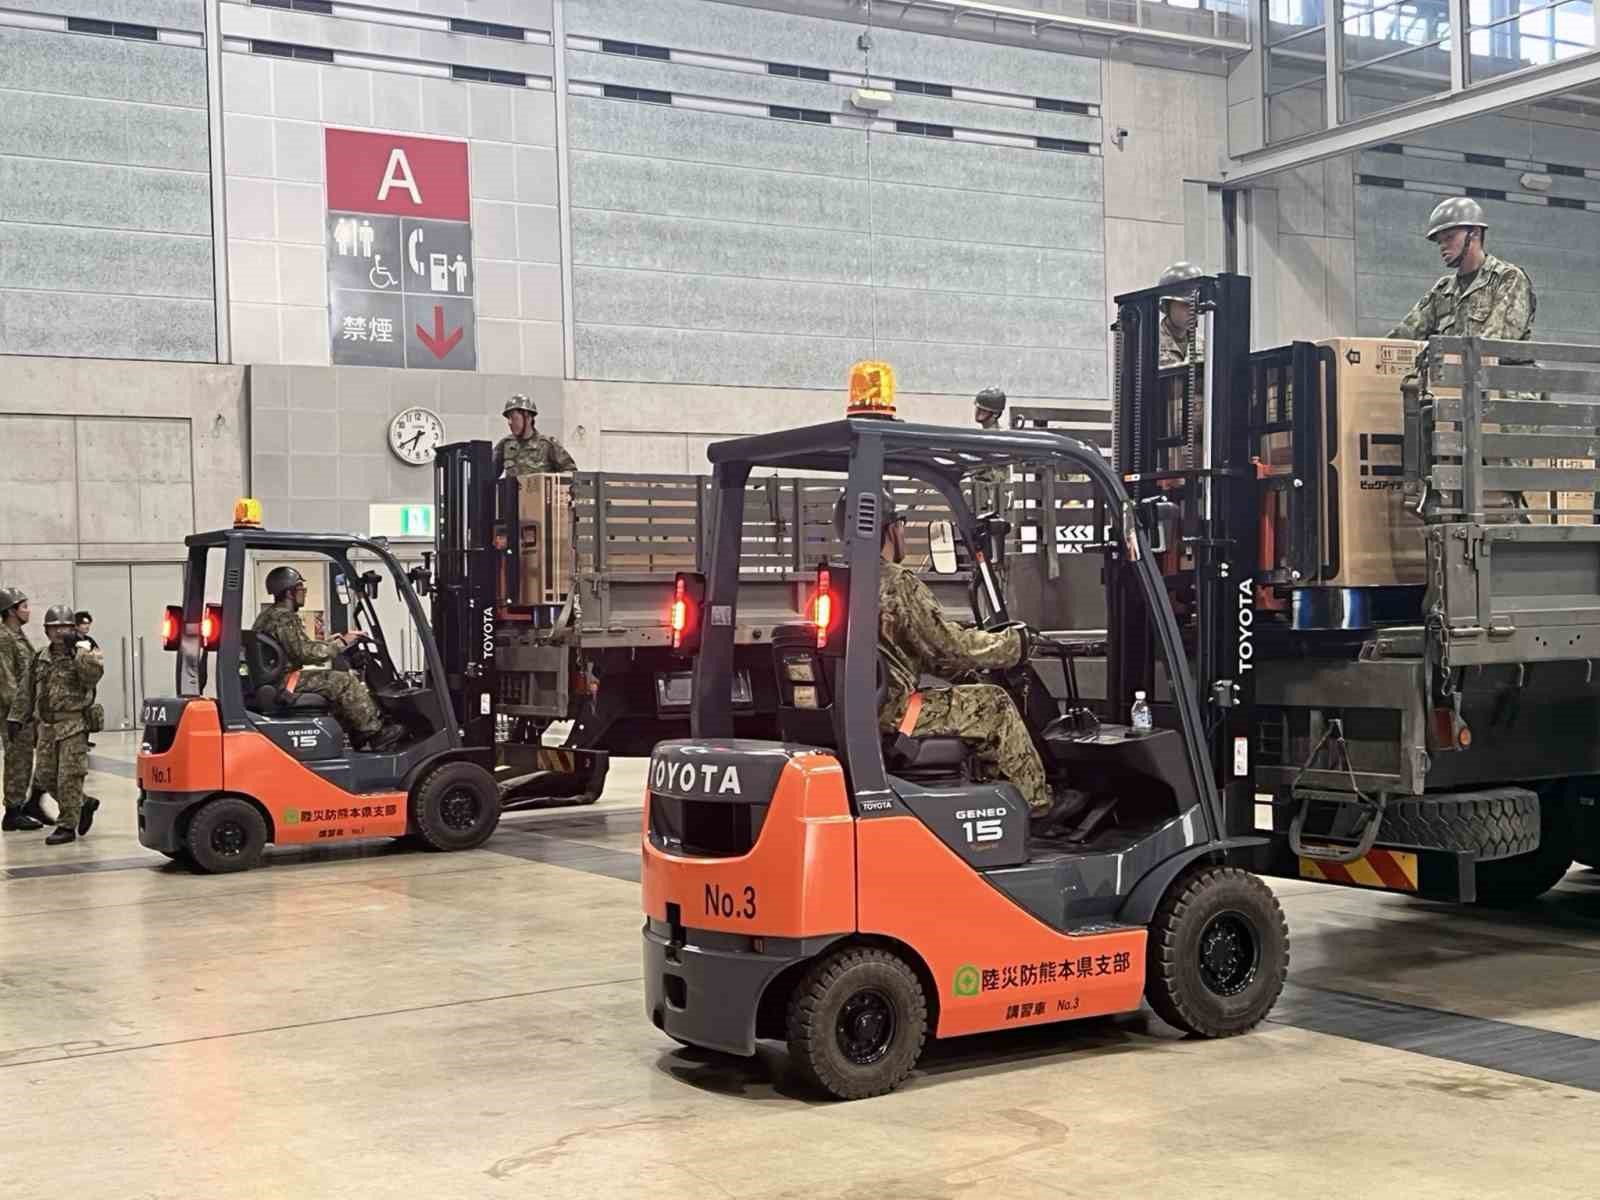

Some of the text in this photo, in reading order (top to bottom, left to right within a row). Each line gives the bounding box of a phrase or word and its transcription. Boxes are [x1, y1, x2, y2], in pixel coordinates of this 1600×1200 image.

[377, 148, 423, 204] A
[343, 315, 393, 343] 禁煙
[484, 607, 494, 659] TOYOTA
[1239, 578, 1253, 674] TOYOTA
[291, 735, 318, 748] 15
[863, 801, 892, 811] TOYOTA
[955, 807, 1007, 820] GENEO
[962, 819, 1003, 843] 15
[705, 883, 756, 919] No.3
[981, 951, 1131, 992] 陸災防熊本県支部
[1005, 998, 1080, 1020] 講習車 No.3
